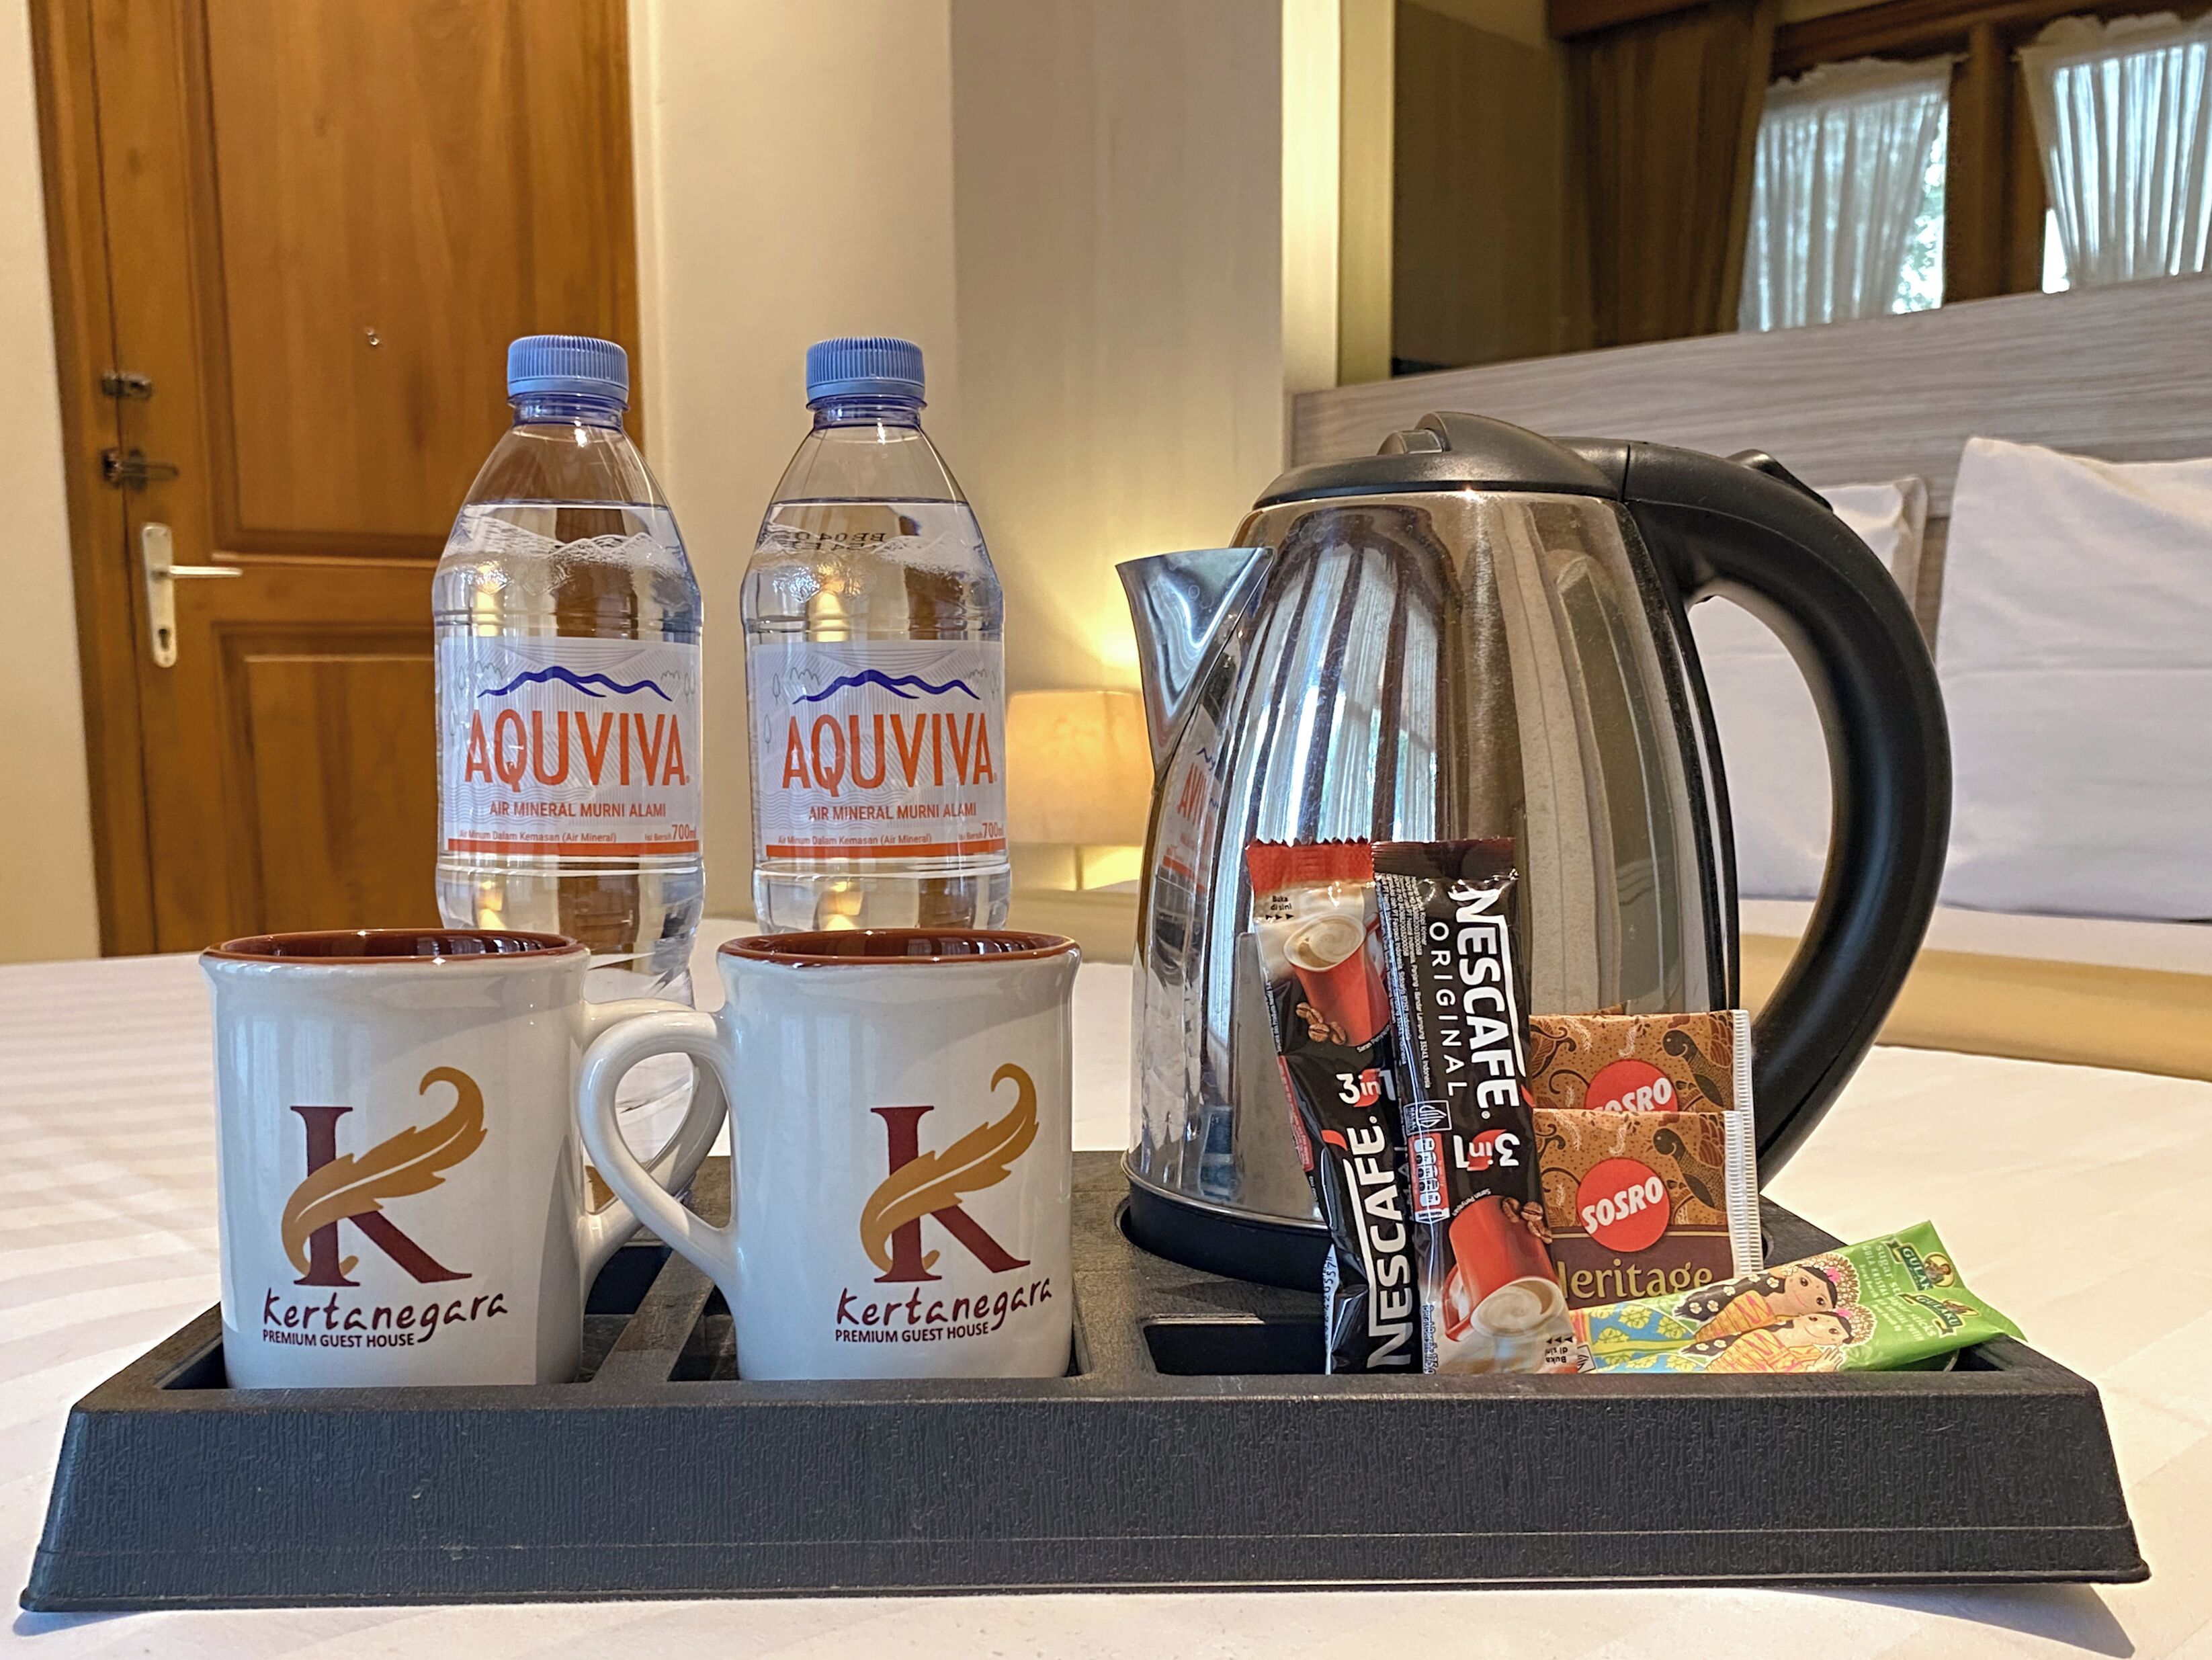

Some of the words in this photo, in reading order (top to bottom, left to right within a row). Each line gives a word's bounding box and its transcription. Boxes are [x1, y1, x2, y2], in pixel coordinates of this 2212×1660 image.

[465, 708, 686, 793] AQUVIVA
[782, 712, 994, 797] AQUVIVA
[490, 801, 509, 816] AIR
[514, 802, 576, 817] MINERAL
[581, 802, 624, 817] MURNI
[629, 803, 665, 817] ALAMI
[808, 806, 829, 821] AIR
[833, 805, 892, 821] MINERAL
[897, 804, 940, 819] MURNI
[943, 802, 976, 818] ALAMI
[493, 831, 517, 840] Dalam
[520, 831, 560, 842] Kemasan
[562, 833, 579, 843] (Air
[581, 832, 616, 843] Mineral)
[812, 835, 837, 845] Dalam
[839, 835, 878, 845] Kemasan
[880, 834, 896, 845] (Air
[898, 833, 932, 844] Mineral)
[1272, 895, 1289, 903] Buka
[1429, 921, 1467, 1097] ORIGINAL
[1416, 1012, 1424, 1040] Lampung
[1422, 1060, 1431, 1088] Indonesia
[1581, 1176, 1664, 1235] SOSRO
[1902, 1247, 1932, 1291] GULAK
[1916, 1296, 1960, 1327] GULAKU
[263, 1329, 317, 1346] PREMIUM
[320, 1335, 364, 1348] GUEST
[366, 1333, 415, 1348] HOUSE
[835, 1328, 898, 1343] PREMIUM
[902, 1328, 943, 1343] GUEST
[947, 1321, 990, 1339] HOUSE
[1545, 1356, 1567, 1364] Buka
